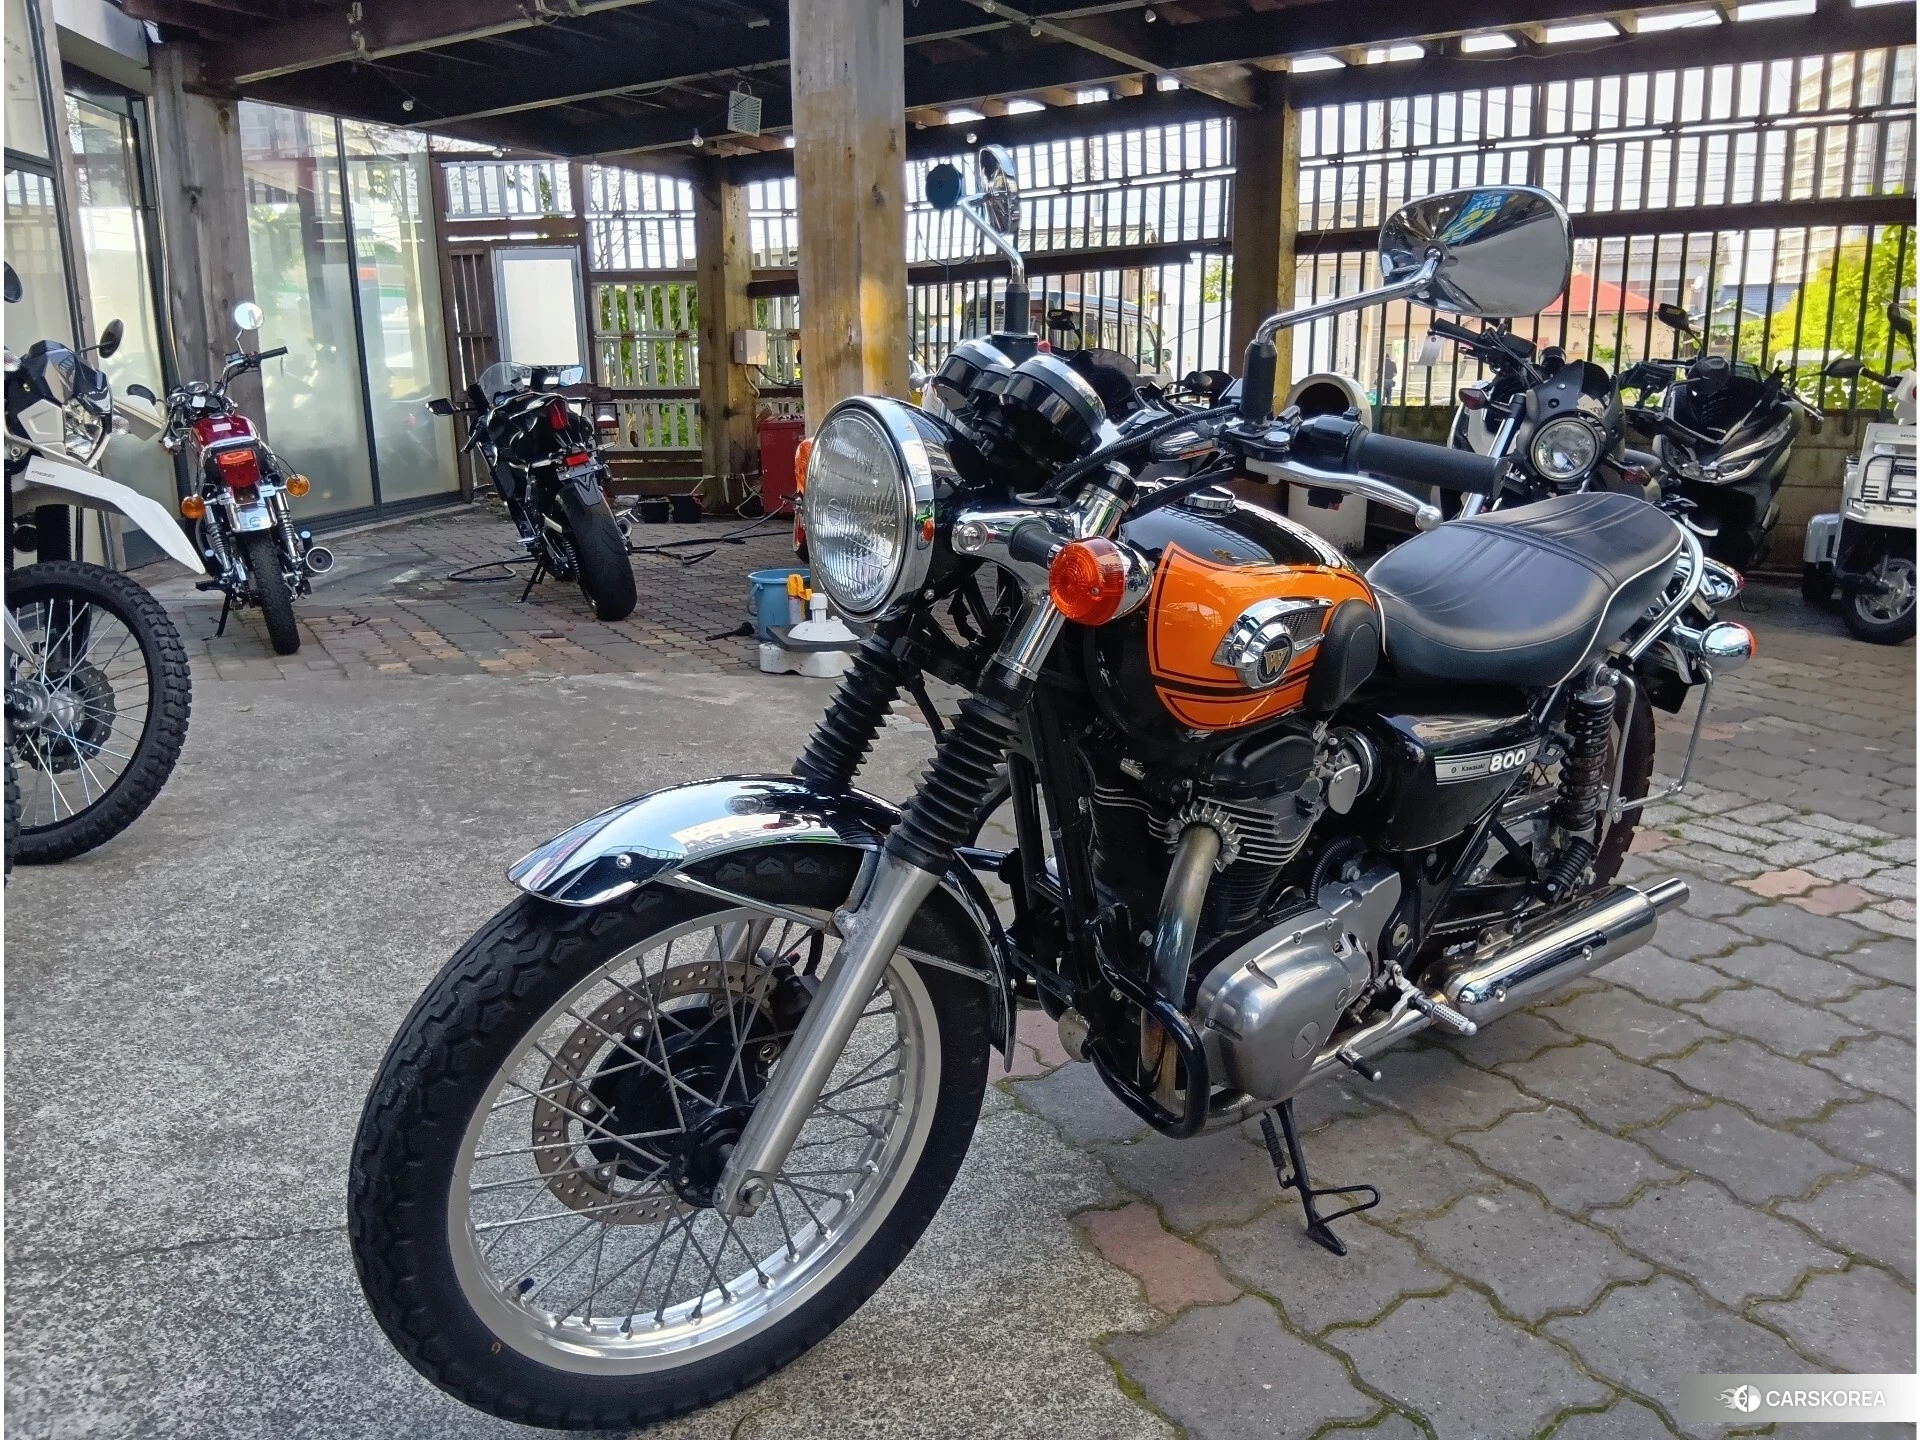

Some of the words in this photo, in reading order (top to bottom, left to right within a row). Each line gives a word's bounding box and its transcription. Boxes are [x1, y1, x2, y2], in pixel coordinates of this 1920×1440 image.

[1263, 647, 1289, 675] W
[1461, 763, 1486, 772] Kawasaki
[1489, 747, 1527, 773] 800
